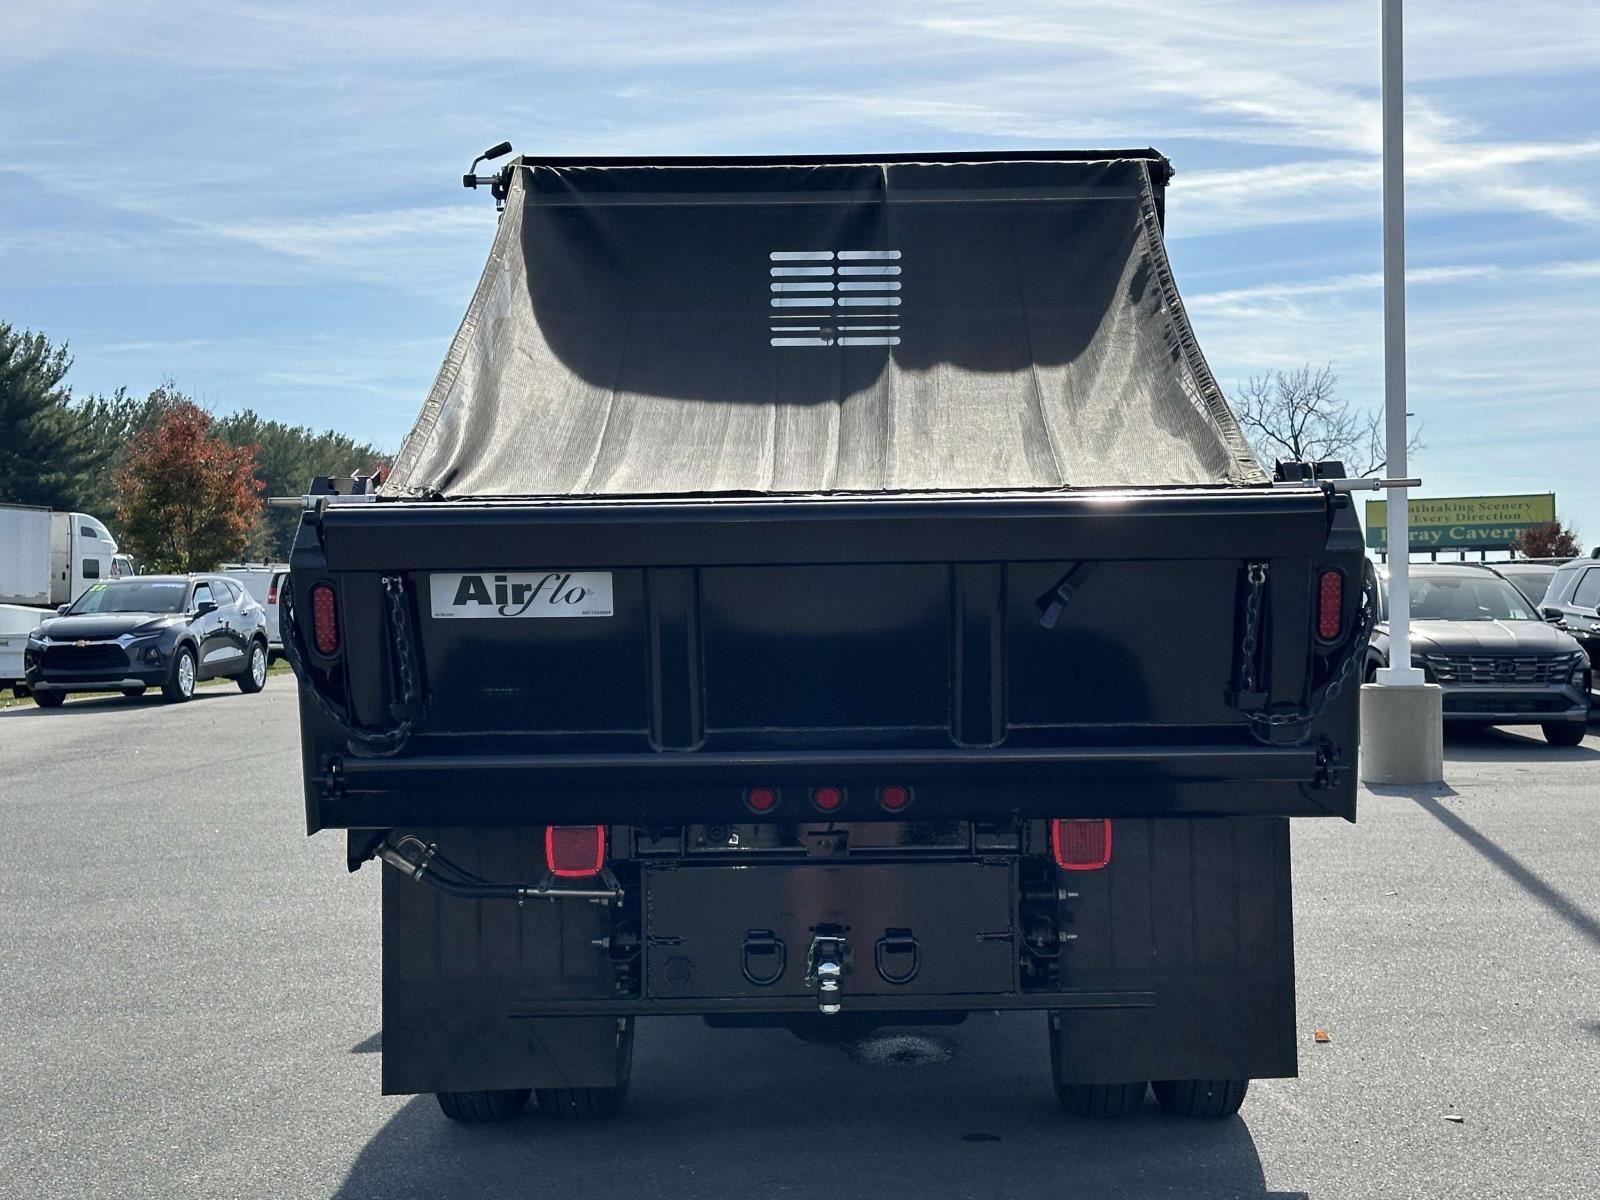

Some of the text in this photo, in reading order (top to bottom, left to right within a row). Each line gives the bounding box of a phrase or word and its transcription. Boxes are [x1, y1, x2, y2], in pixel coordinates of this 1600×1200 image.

[1408, 501, 1532, 513] athtaking Scenery
[1414, 511, 1521, 524] Every Direction
[1380, 526, 1524, 544] Lray Cavern
[452, 573, 586, 617] Airflo
